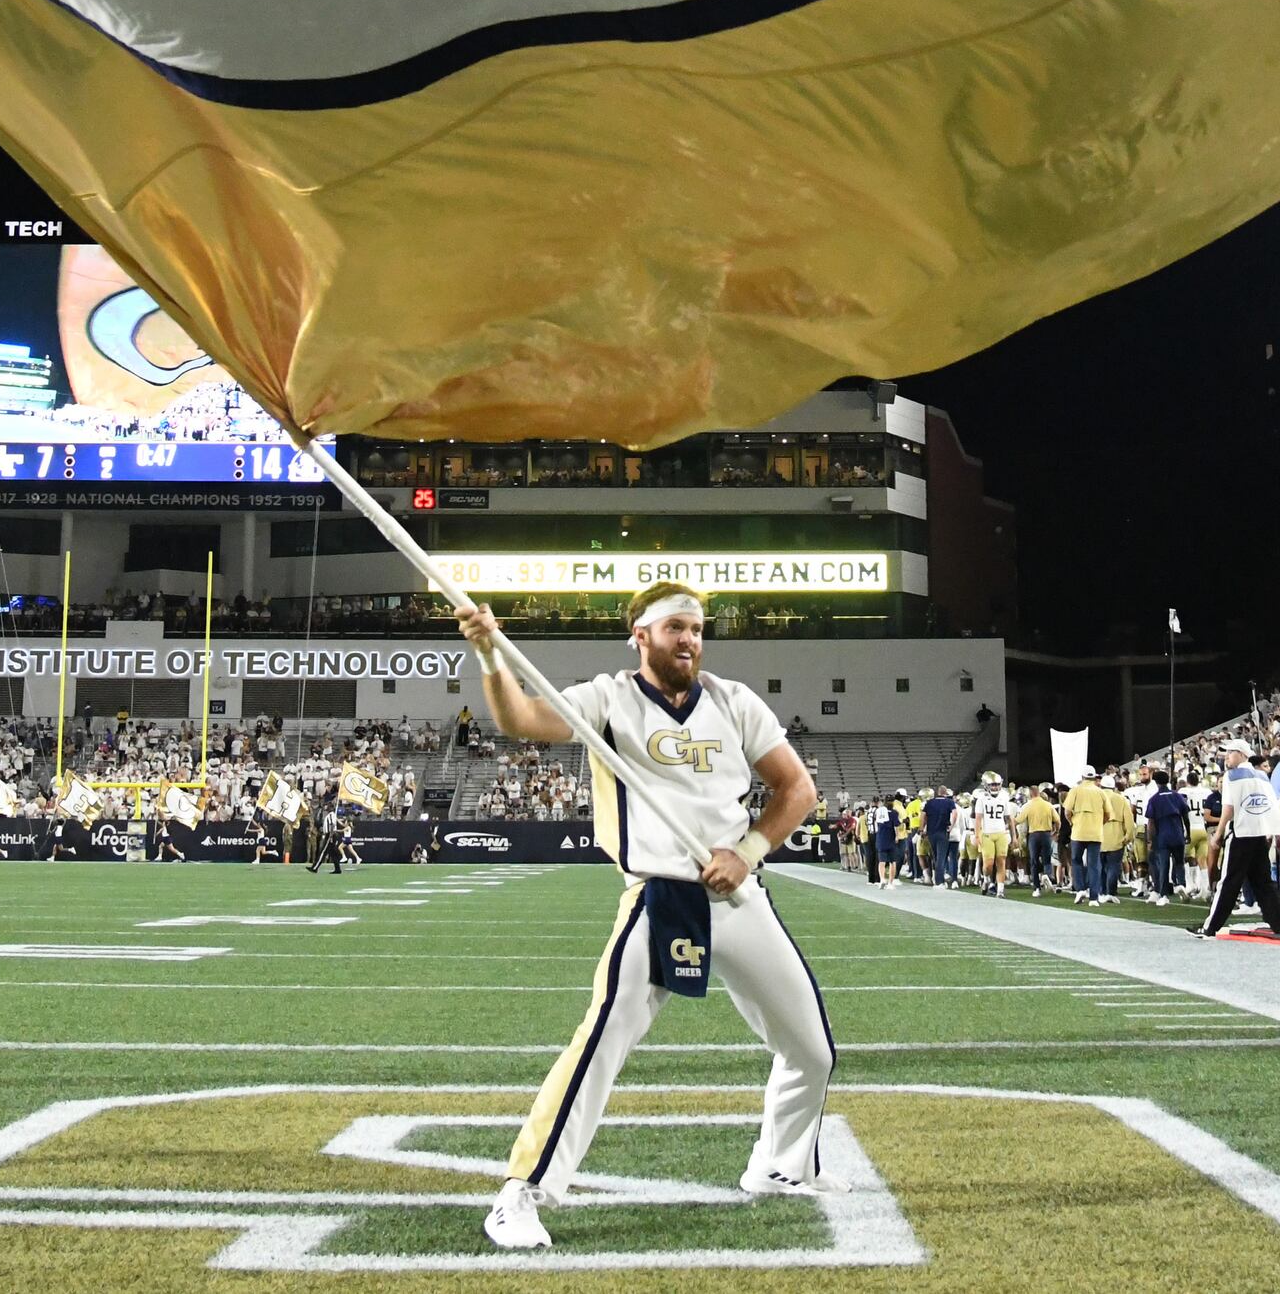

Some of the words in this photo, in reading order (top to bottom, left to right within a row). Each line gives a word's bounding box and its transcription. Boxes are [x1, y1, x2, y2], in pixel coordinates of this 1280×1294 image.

[5, 220, 63, 237] TECH
[36, 445, 54, 478] 7
[100, 458, 114, 479] 2
[251, 447, 282, 479] 14
[24, 492, 57, 504] 1928
[66, 493, 145, 505] NATIONAL
[149, 494, 240, 506] CHAMPIONS
[248, 495, 282, 506] 1952
[290, 495, 325, 506] 1990
[414, 489, 434, 508] 25
[166, 650, 211, 675] OF
[223, 651, 465, 676] TECHNOLOGY
[646, 727, 723, 773] GT
[265, 779, 302, 823] H
[1247, 797, 1269, 807] ACC
[985, 804, 1005, 820] 42
[91, 824, 129, 856] Krog
[217, 836, 256, 846] Invesco
[457, 837, 510, 847] SCANA
[670, 938, 706, 966] GT
[674, 966, 702, 977] CHEER
